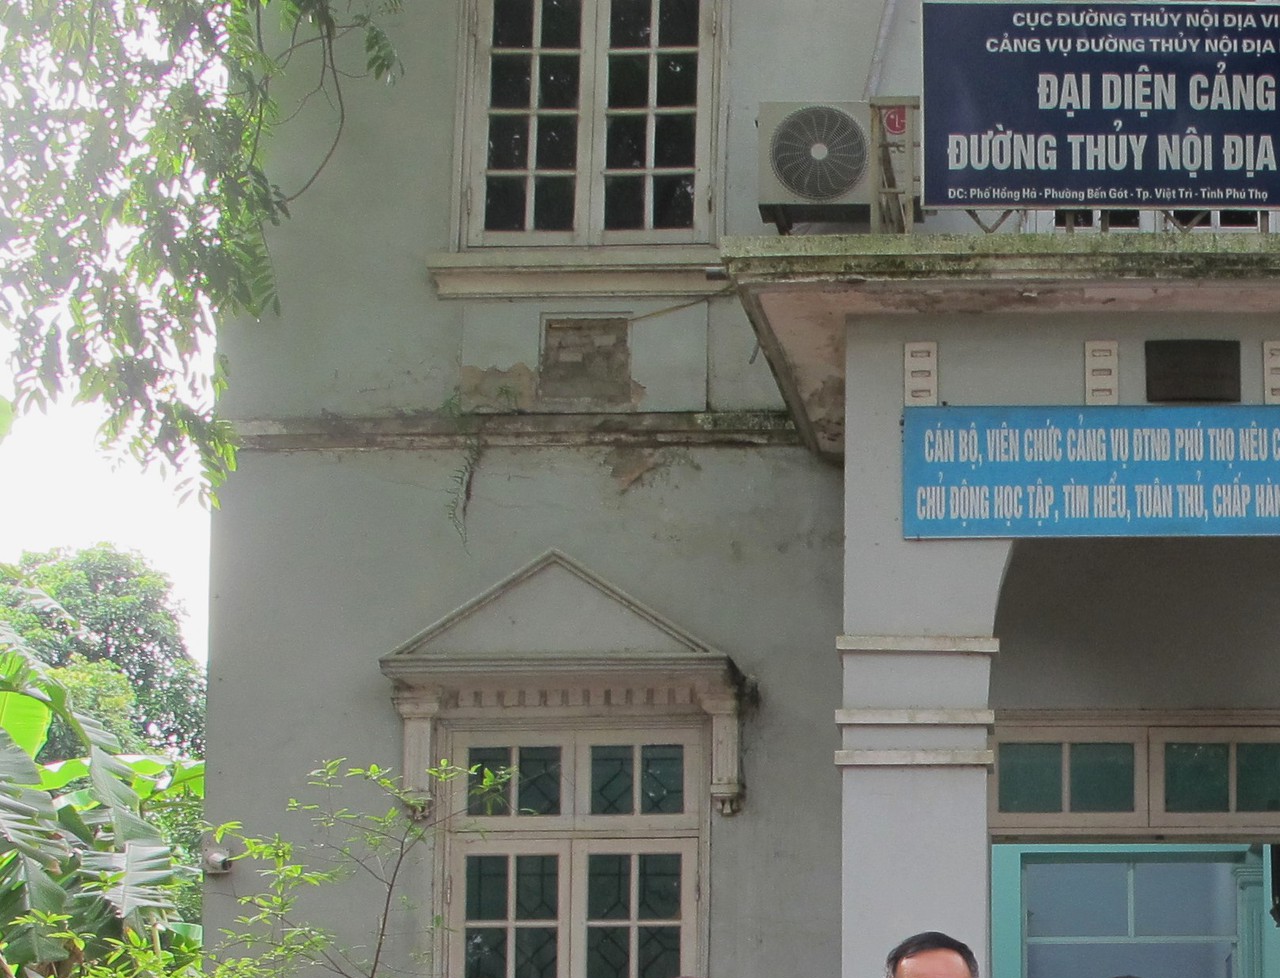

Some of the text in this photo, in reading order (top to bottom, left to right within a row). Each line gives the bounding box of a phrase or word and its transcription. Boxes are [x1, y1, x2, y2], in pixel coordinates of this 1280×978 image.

[986, 32, 1041, 52] CẢNG
[1045, 39, 1072, 56] VỤ
[1075, 34, 1145, 52] ĐƯỜNG
[1149, 32, 1200, 53] THỦY
[1205, 36, 1238, 56] NỘI
[1242, 39, 1275, 57] ĐỊA
[1012, 12, 1053, 31] CỤC
[1056, 8, 1127, 27] ĐƯỜNG
[1131, 7, 1183, 27] THỦY
[1186, 9, 1219, 32] NỘI
[1223, 13, 1257, 32] ĐỊA
[1037, 73, 1091, 117] ĐẠI
[1102, 64, 1176, 117] DIỆN
[1189, 61, 1276, 111] CẢNG
[947, 123, 1057, 171] ĐƯỜNG
[1067, 119, 1148, 171] THỦY
[1157, 126, 1213, 178] NỘI
[1222, 134, 1277, 178] ĐỊA
[970, 186, 991, 199] Phố
[1044, 187, 1085, 201] Phường
[1225, 188, 1246, 199] Phú
[1248, 188, 1268, 202] Thọ
[924, 422, 955, 463] CÁN
[986, 421, 1020, 462] VIÊN
[1023, 419, 1062, 462] CHỨC
[1066, 414, 1107, 462] CẢNG
[1110, 428, 1129, 469] VỤ
[1174, 421, 1204, 462] PHÚ
[1207, 428, 1235, 469] THỌ
[1239, 420, 1268, 462] NÊU
[916, 471, 946, 520] CHỦ
[949, 479, 990, 527] ĐỘNG
[994, 485, 1023, 527] HỌC
[1062, 477, 1089, 519] TÌM
[1134, 477, 1173, 518] TUÂN
[1212, 471, 1251, 518] CHẤP
